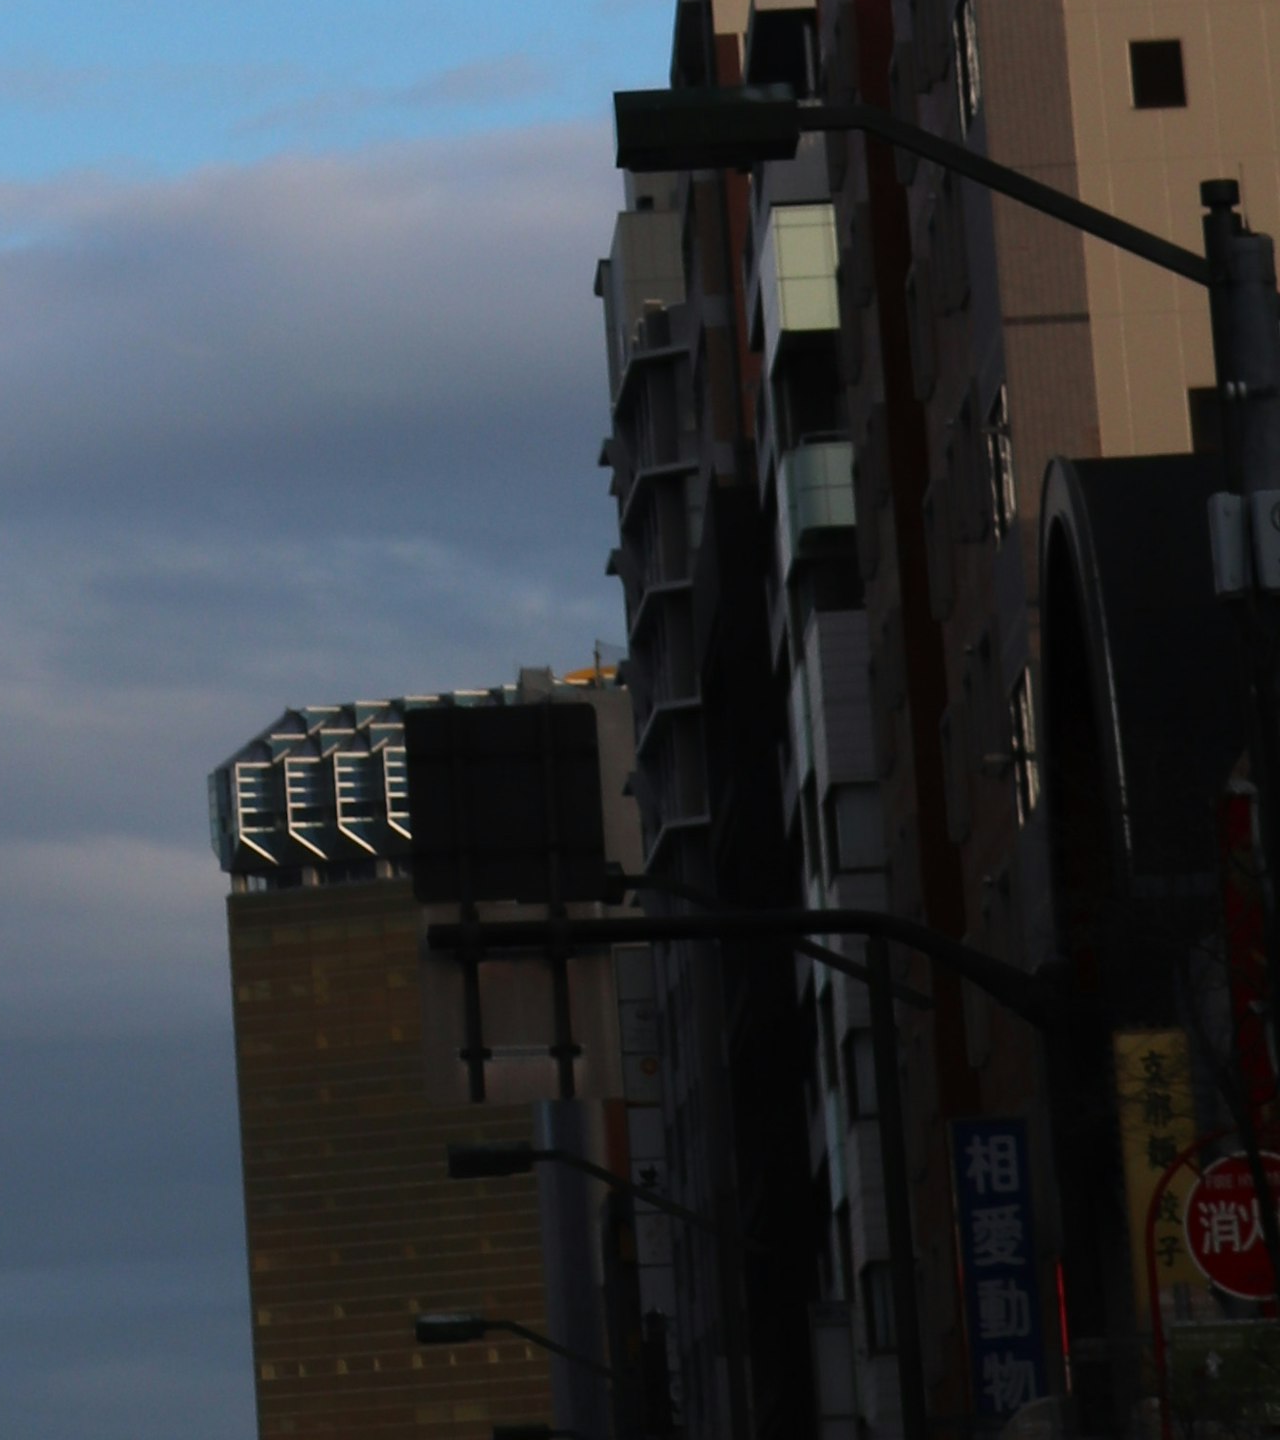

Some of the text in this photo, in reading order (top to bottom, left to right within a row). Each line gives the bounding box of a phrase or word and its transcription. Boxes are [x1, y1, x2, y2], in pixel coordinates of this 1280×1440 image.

[965, 1134, 1037, 1413] 相愛動物
[1197, 1200, 1280, 1255] 消火
